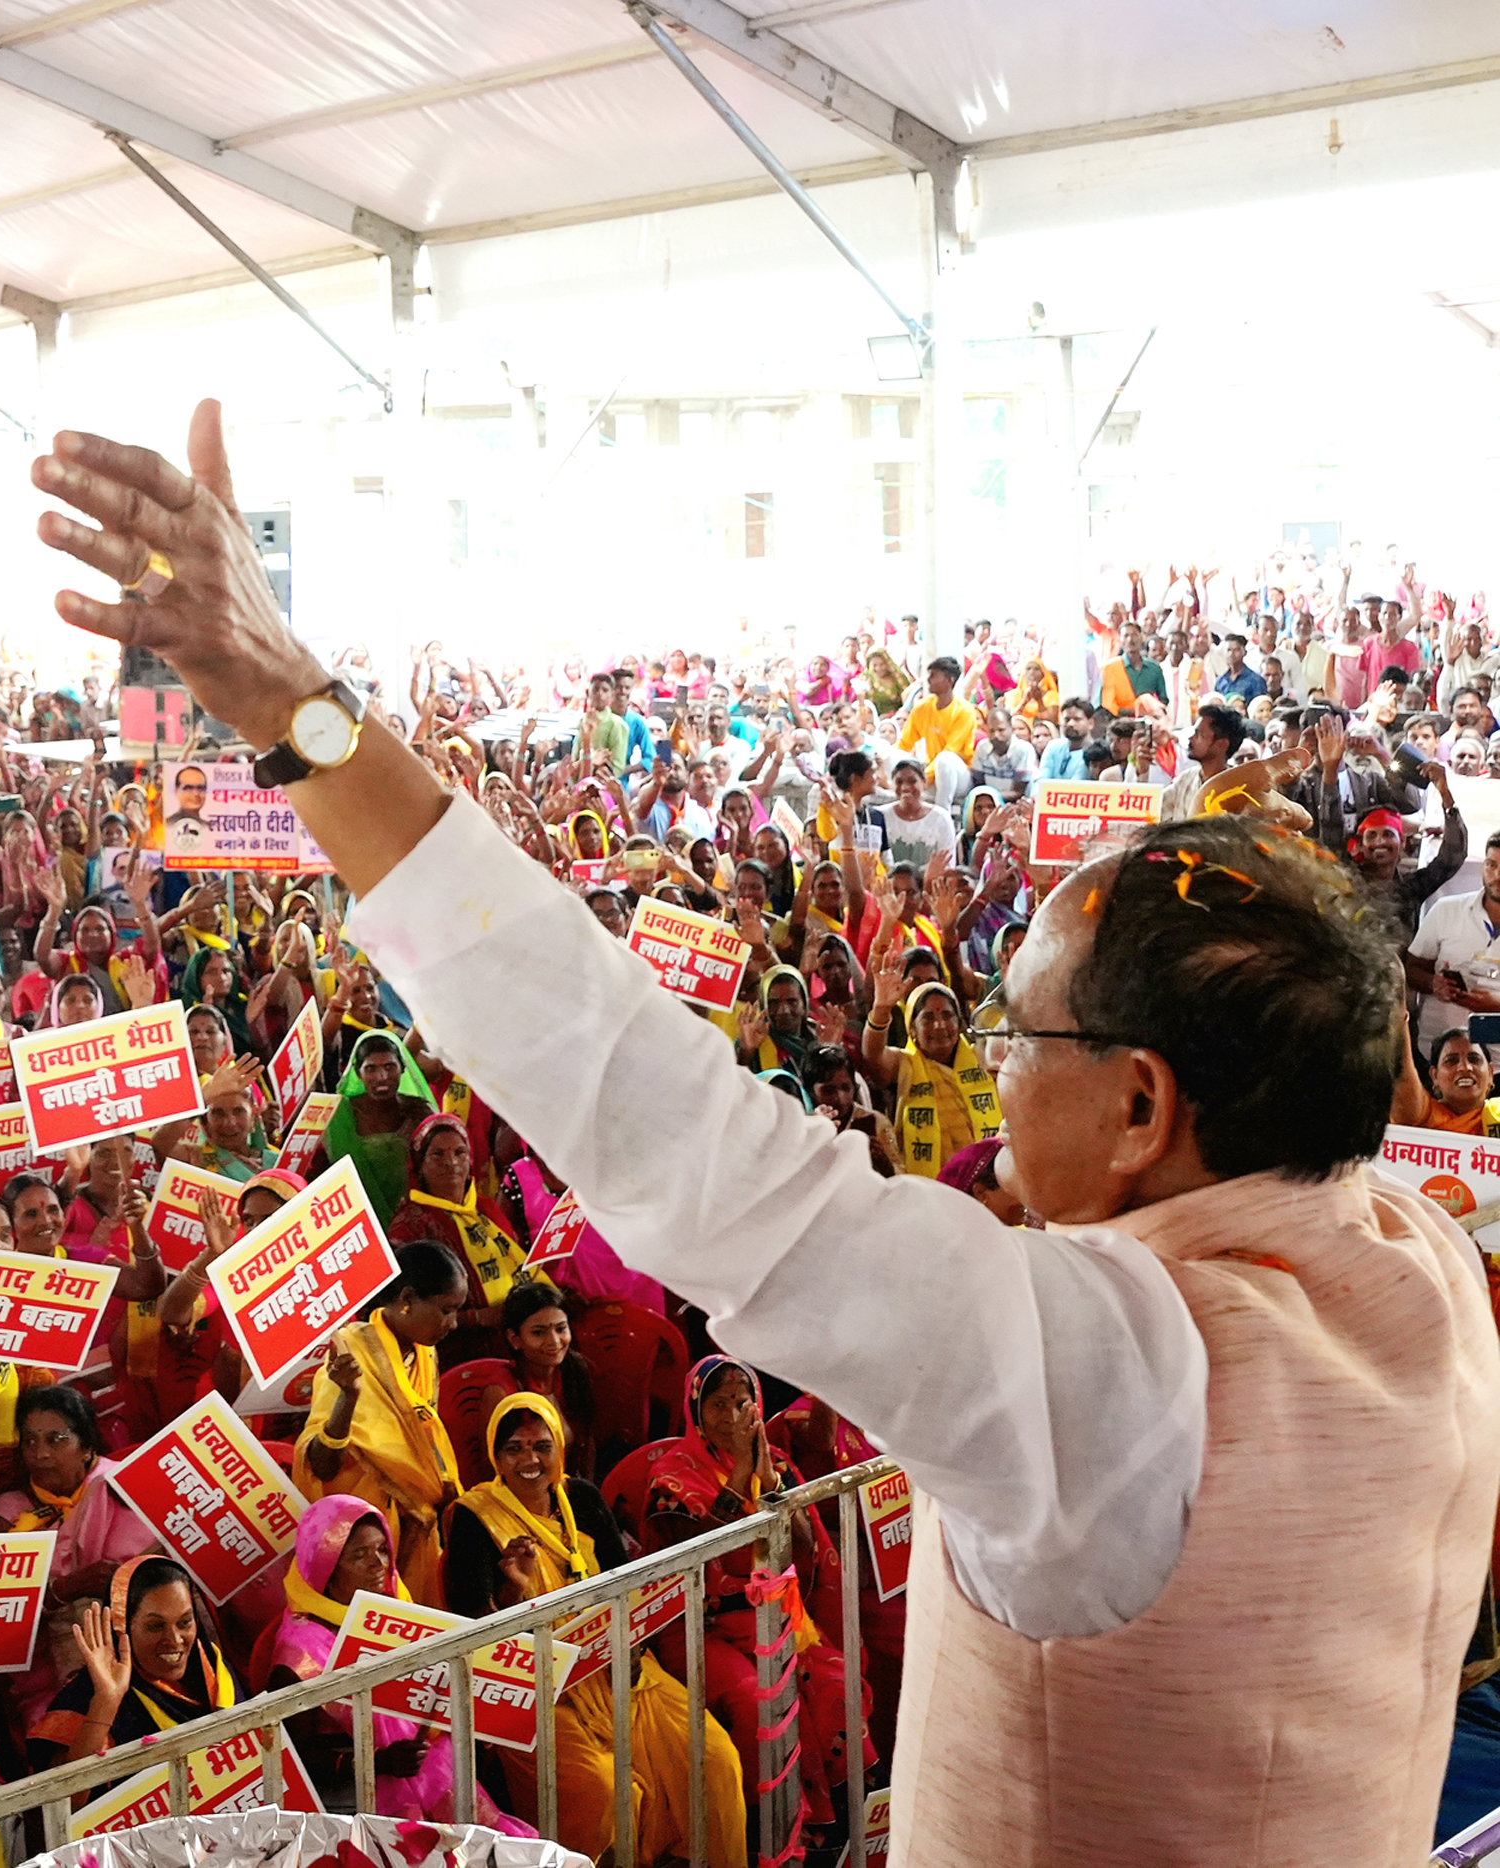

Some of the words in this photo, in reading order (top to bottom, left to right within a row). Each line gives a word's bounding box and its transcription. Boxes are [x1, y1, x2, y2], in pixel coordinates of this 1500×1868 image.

[1047, 792, 1110, 812] धन्यवाद
[1118, 789, 1152, 811] भैया
[208, 811, 261, 832] लखपति
[267, 811, 294, 832] दीदी
[1047, 815, 1102, 838] लाड़ली
[216, 836, 245, 850] बनाने
[251, 837, 260, 850] के
[265, 838, 289, 850] लिए
[644, 911, 704, 945] धन्यवाद
[710, 928, 744, 955] भैया
[664, 967, 699, 992] सेना
[694, 956, 735, 981] बहना
[28, 1034, 117, 1073] धन्यवाद
[127, 1021, 173, 1049] भैया
[39, 1068, 117, 1109] लाड़ली
[122, 1056, 181, 1089] बहना
[92, 1095, 143, 1125] सेना
[1383, 1140, 1461, 1175] धन्यवाद
[1471, 1145, 1500, 1176] भैय
[228, 1221, 309, 1295] धन्यवाद
[310, 1185, 352, 1229] भैया
[44, 1269, 100, 1299] भैया
[249, 1262, 319, 1333] लाड़ली
[317, 1222, 369, 1275] बहना
[19, 1305, 86, 1333] बहना
[301, 1280, 349, 1329] सेना
[192, 1415, 264, 1499] धन्यवाद
[256, 1492, 298, 1540] भैया
[158, 1446, 224, 1517] लाड़ली
[214, 1511, 265, 1566] बहना
[164, 1504, 211, 1554] सेना
